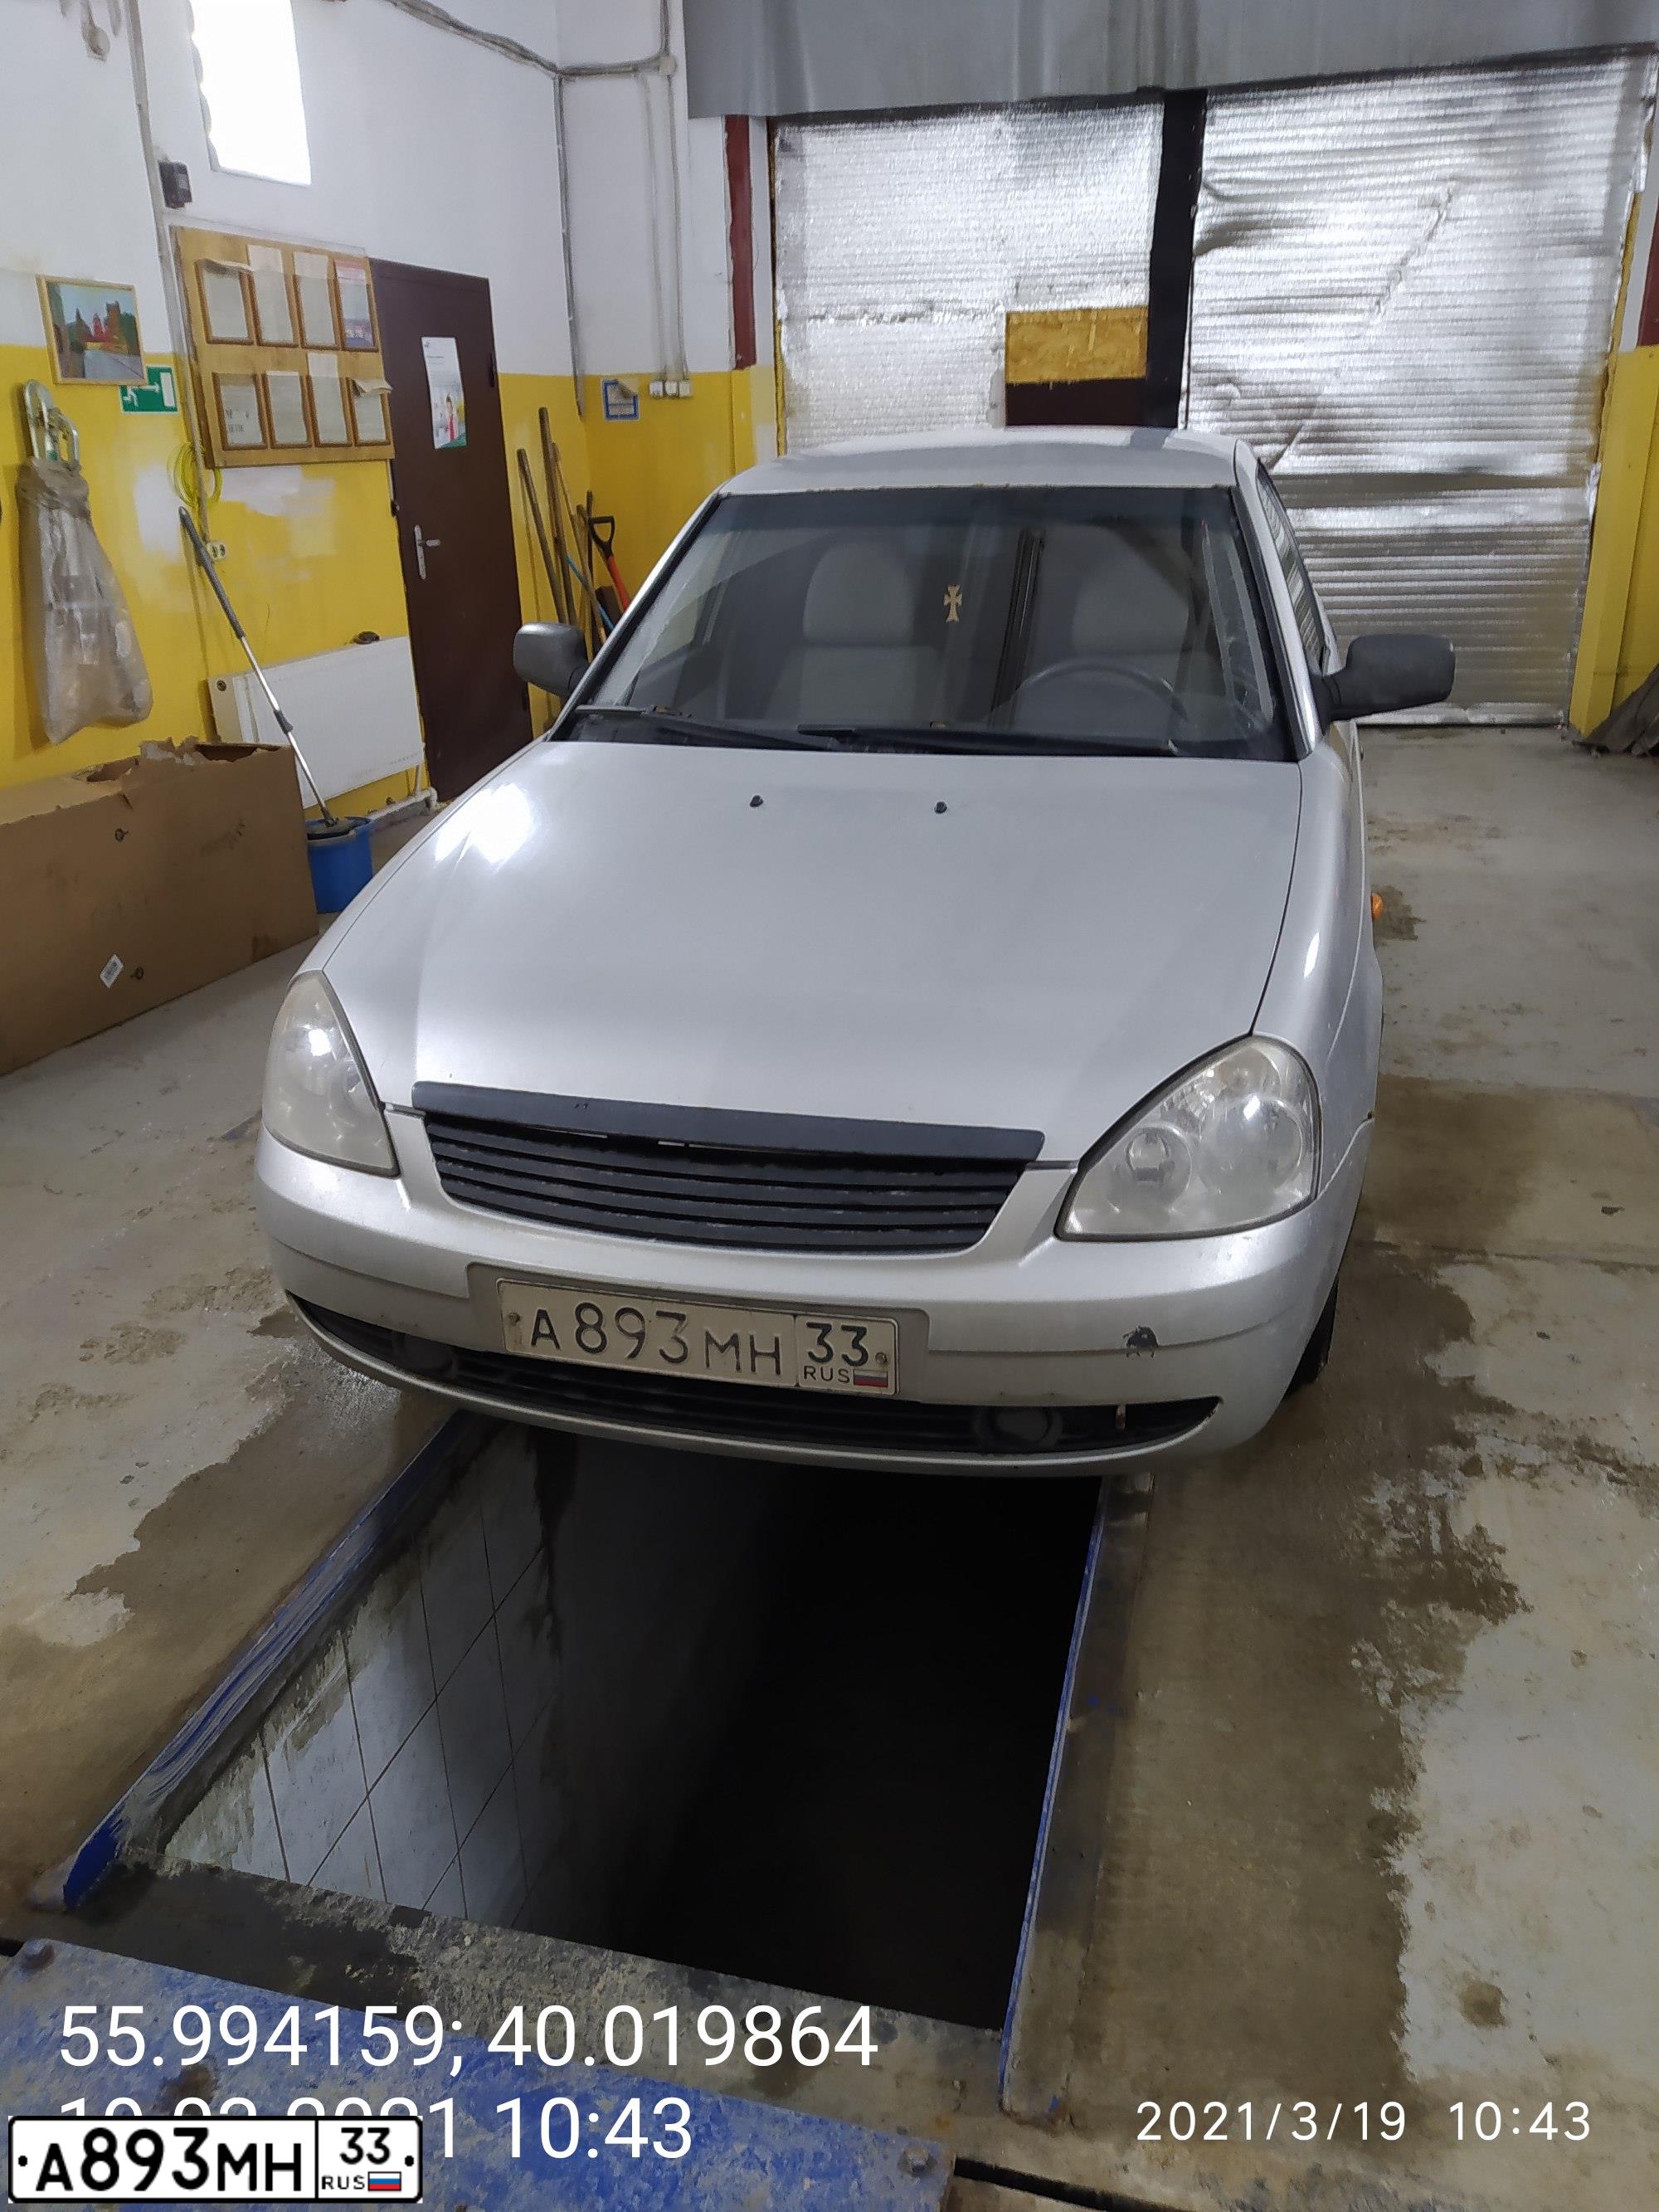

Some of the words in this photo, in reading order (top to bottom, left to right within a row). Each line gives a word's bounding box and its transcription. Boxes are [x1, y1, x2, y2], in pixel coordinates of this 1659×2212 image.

[530, 1302, 781, 1376] А893МН
[805, 1322, 868, 1367] 33
[802, 1365, 850, 1385] RUS
